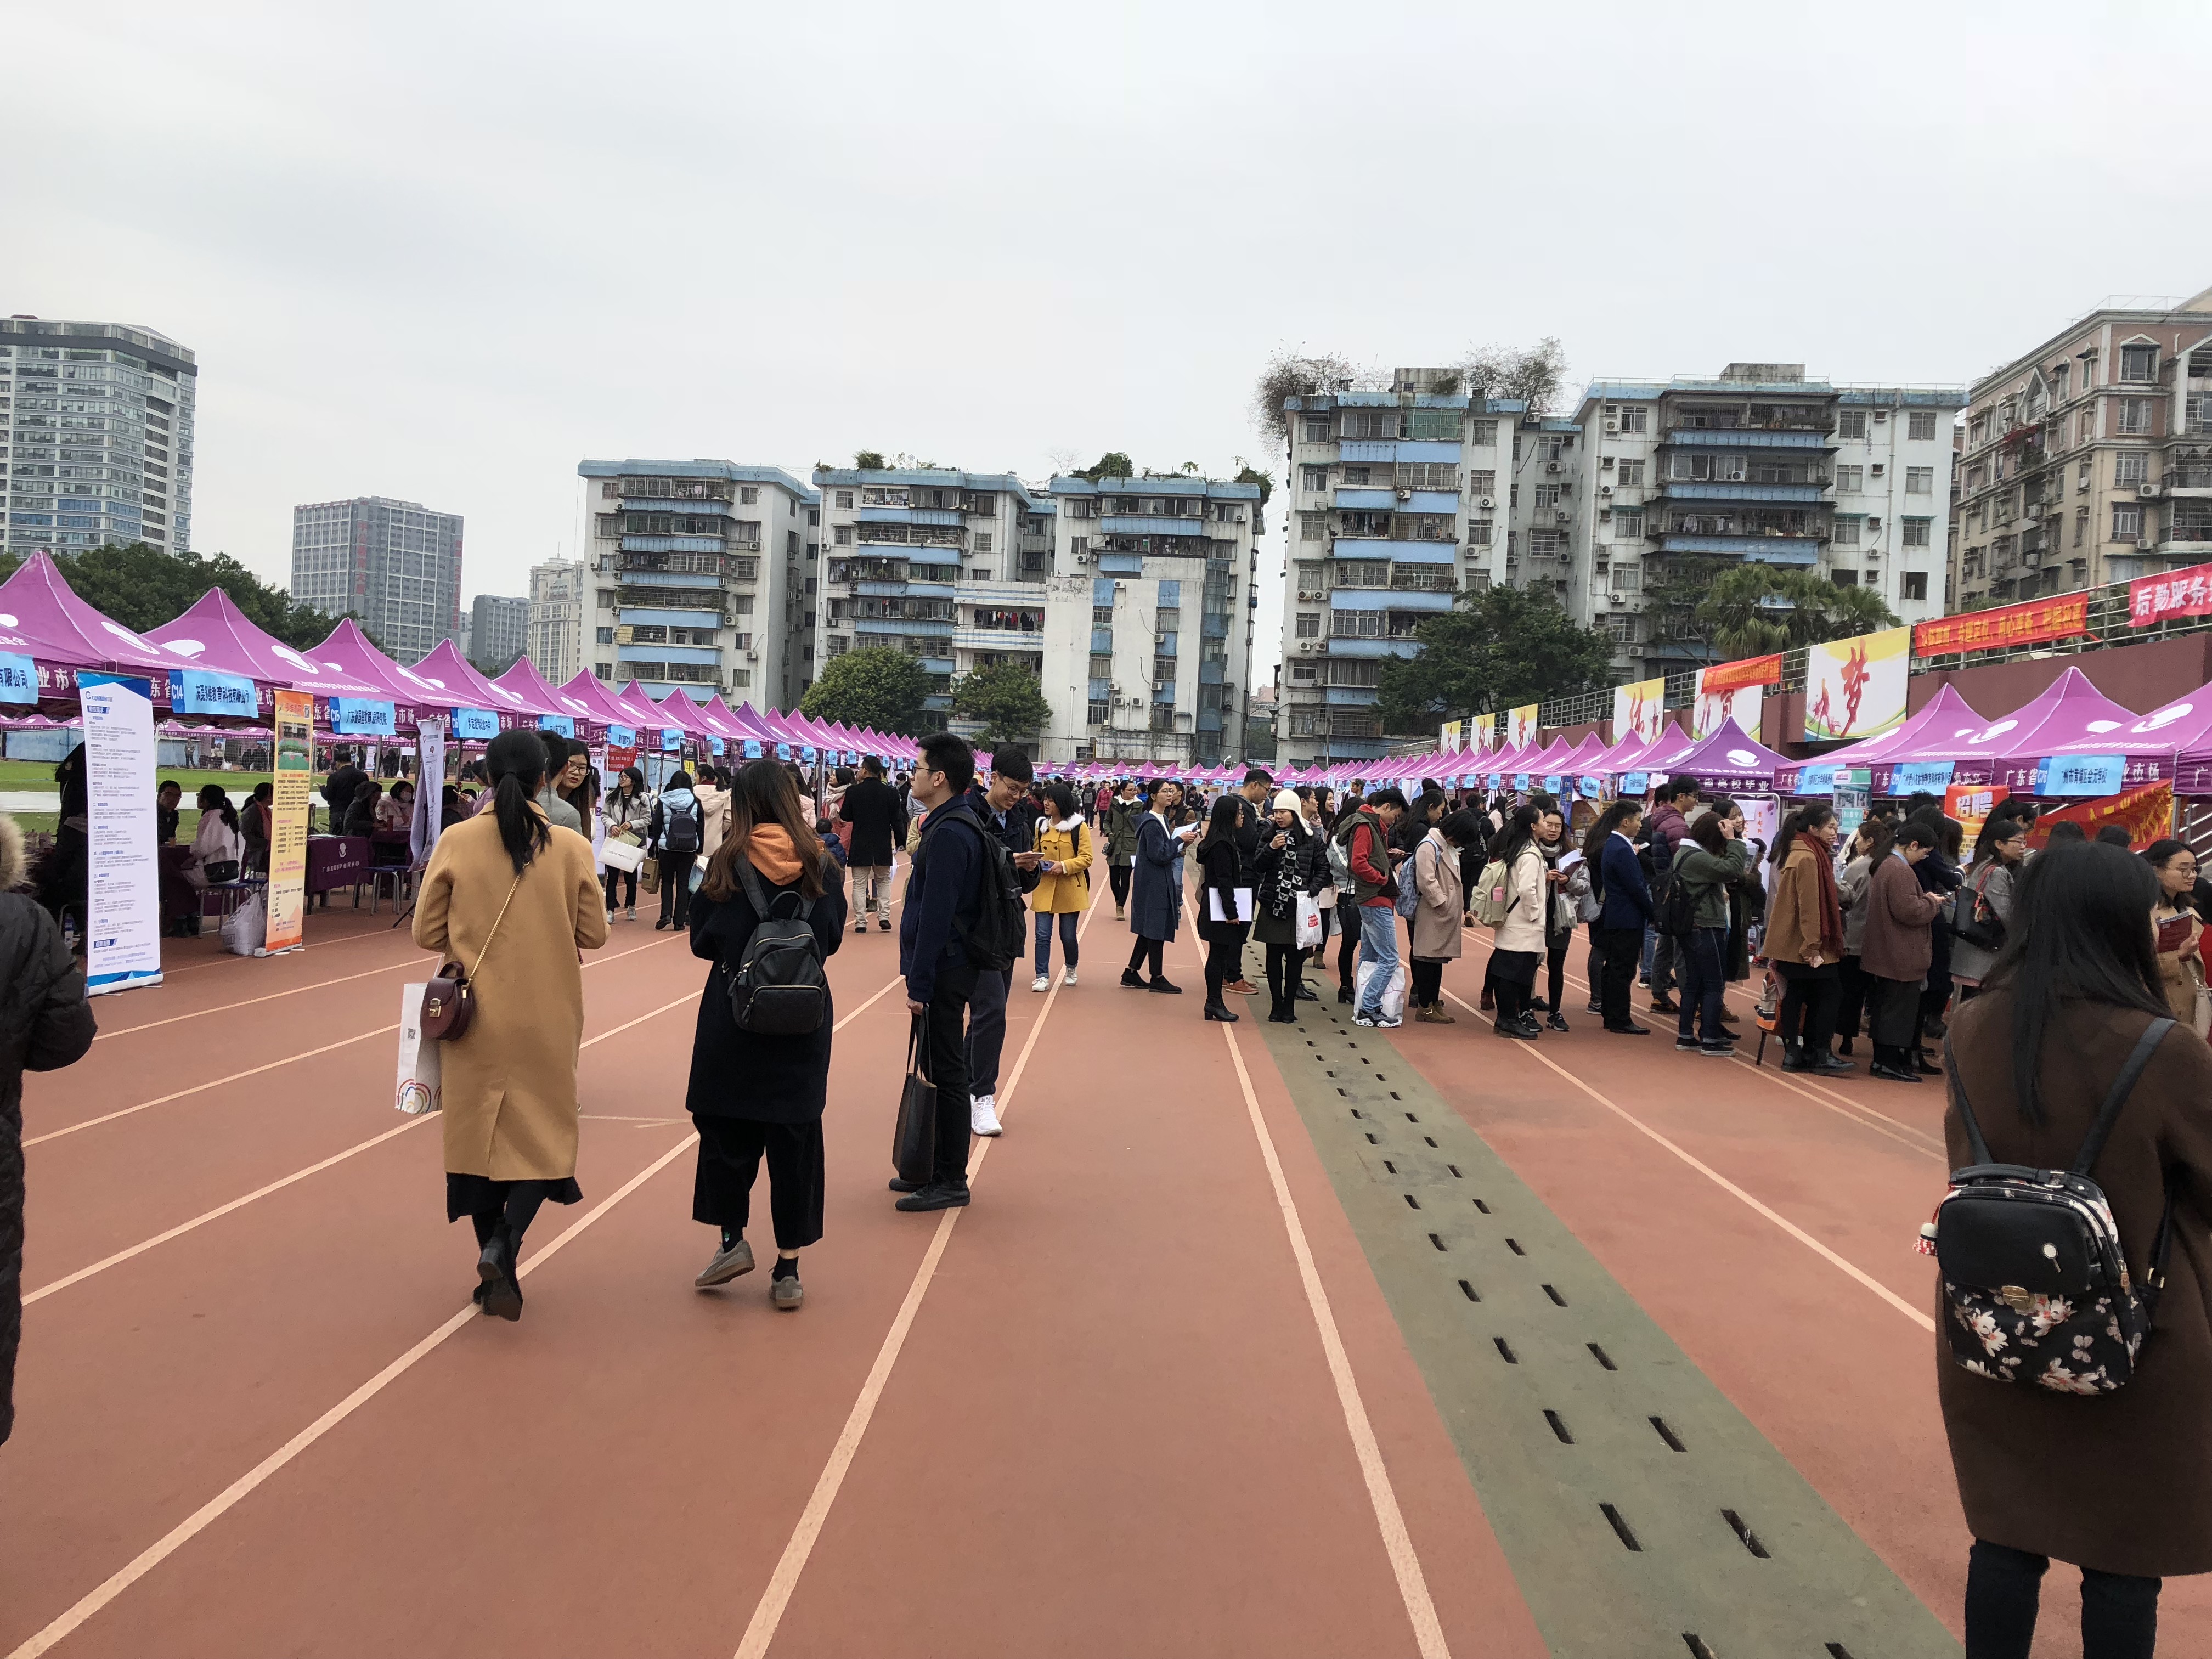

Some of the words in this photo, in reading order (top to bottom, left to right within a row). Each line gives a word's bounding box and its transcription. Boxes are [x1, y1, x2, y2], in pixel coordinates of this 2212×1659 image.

[172, 684, 183, 700] C14
[331, 708, 341, 723] C15
[394, 708, 414, 724] 市场
[1696, 777, 1769, 792] 省高校毕业
[2006, 768, 2038, 787] 广东省
[1956, 791, 1993, 817] 招聘
